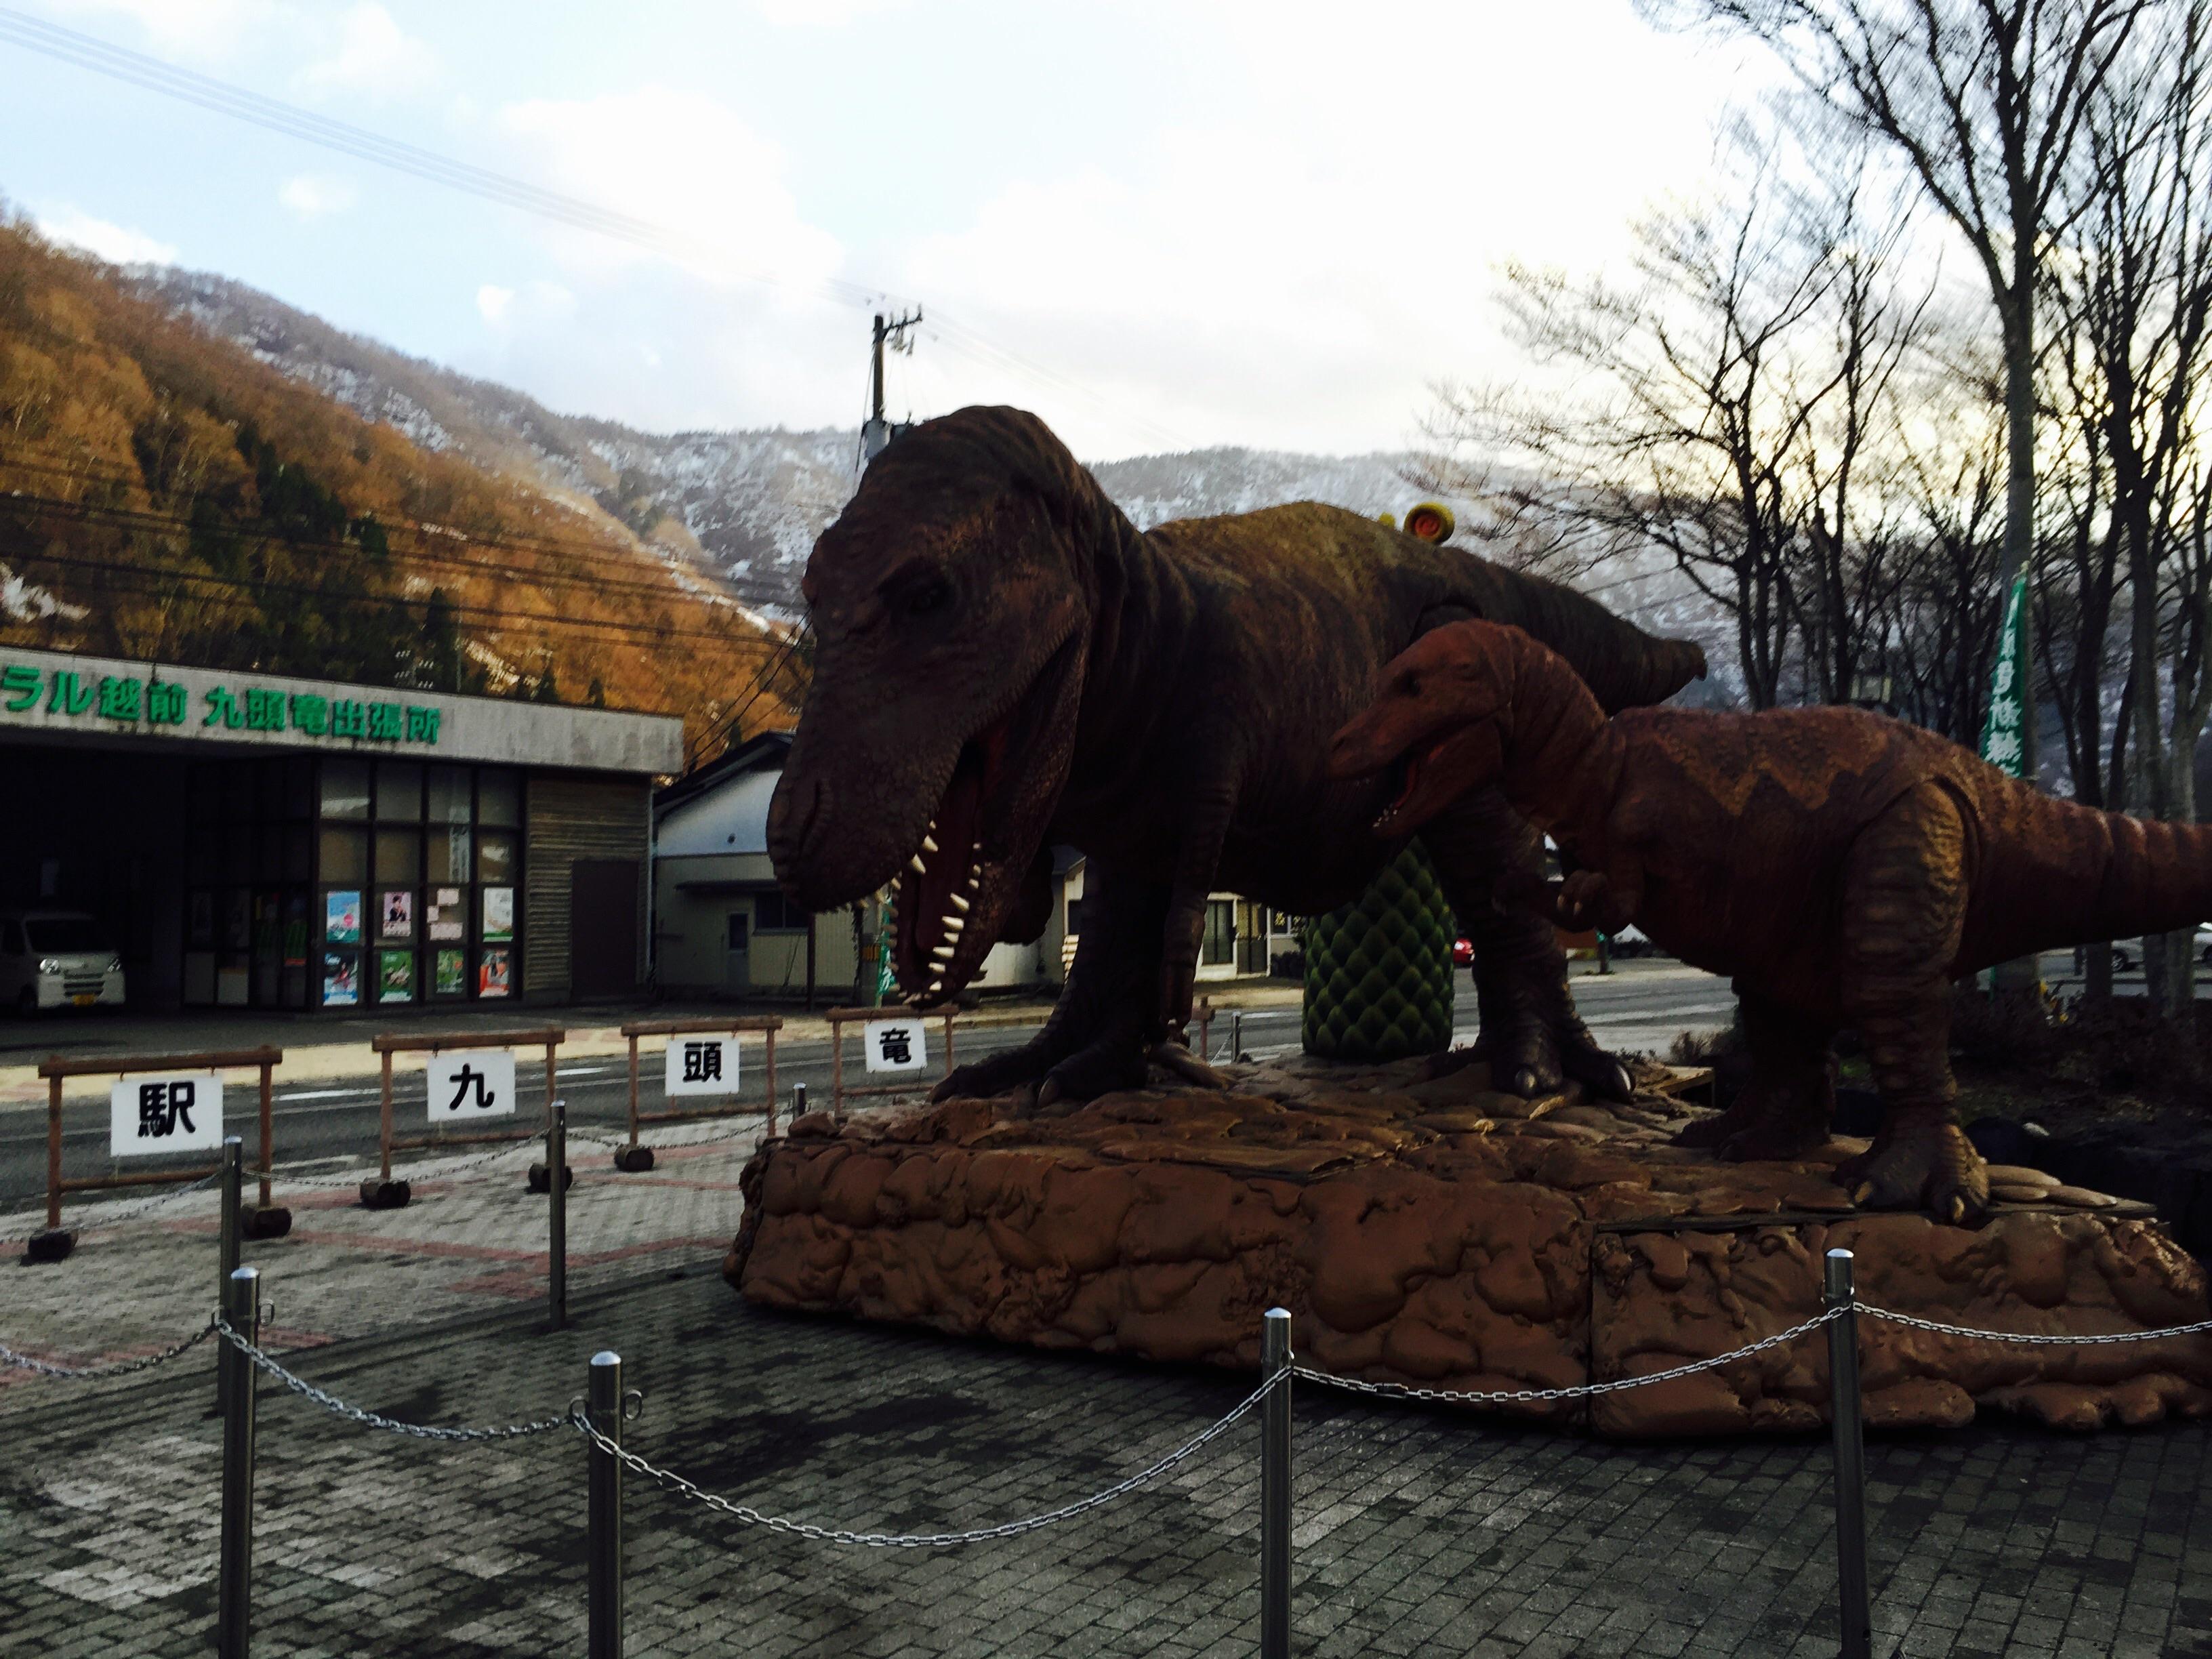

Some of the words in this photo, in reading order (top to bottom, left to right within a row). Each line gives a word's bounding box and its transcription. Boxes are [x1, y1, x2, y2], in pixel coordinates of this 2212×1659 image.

[3, 665, 188, 725] ラル越前
[203, 685, 441, 745] 九頭竜出張所
[682, 1042, 722, 1082] 頭
[879, 1027, 911, 1063] 竜
[138, 1081, 196, 1137] 駅
[449, 1063, 495, 1109] 九
